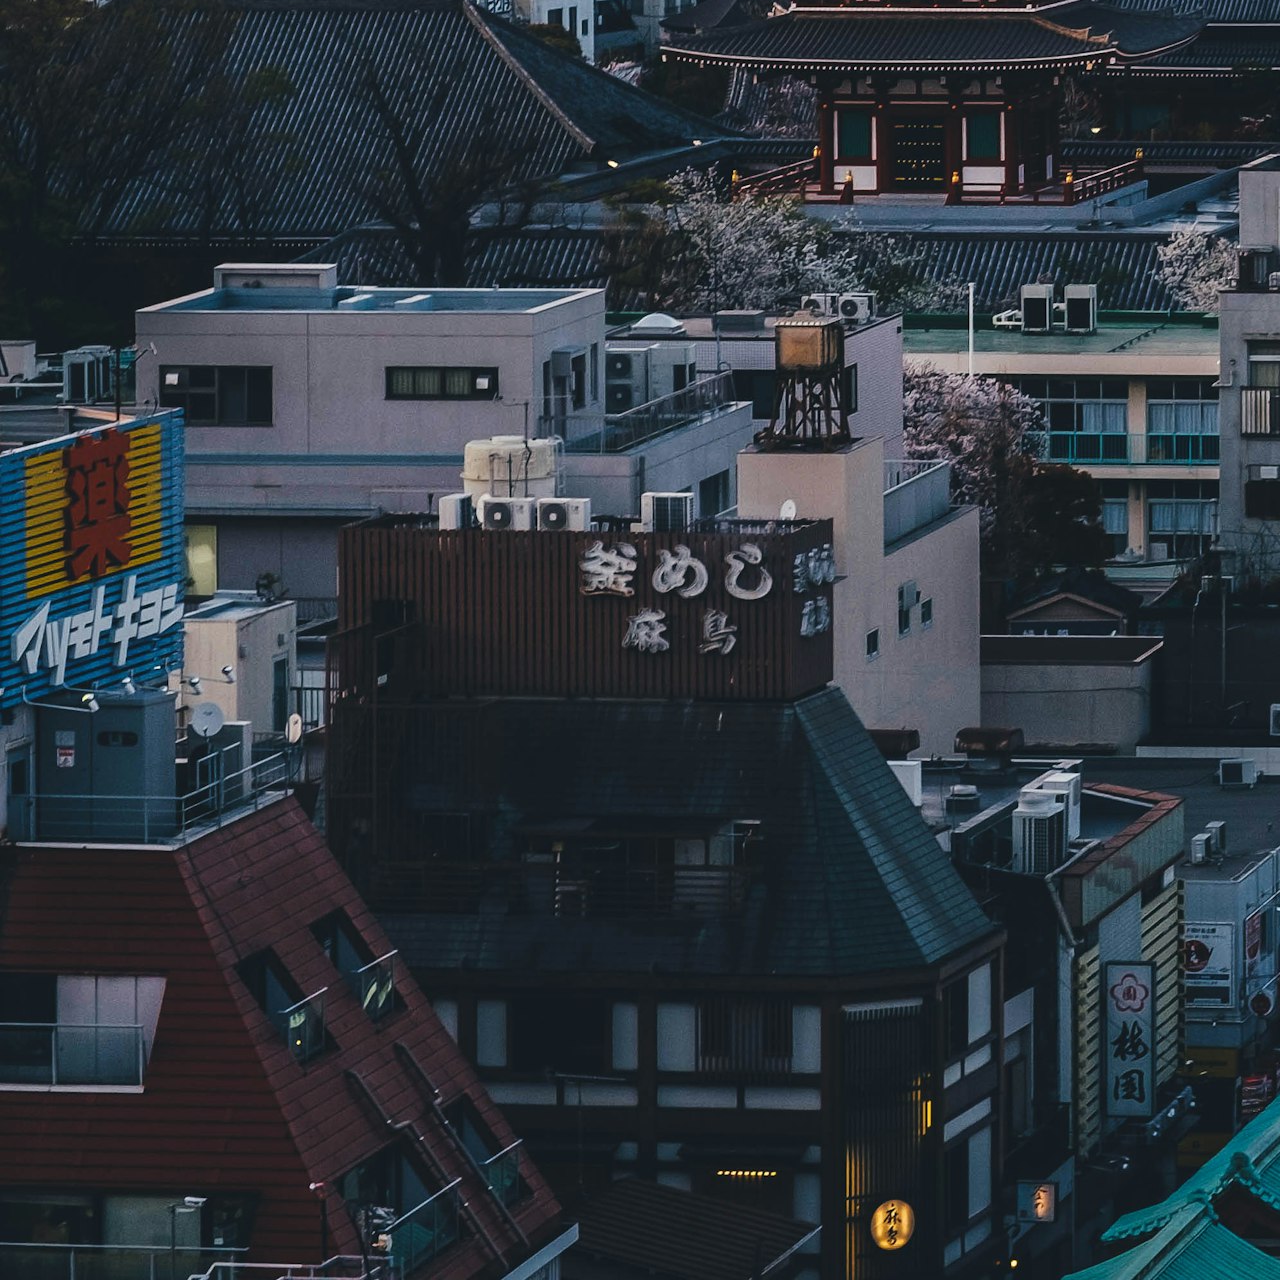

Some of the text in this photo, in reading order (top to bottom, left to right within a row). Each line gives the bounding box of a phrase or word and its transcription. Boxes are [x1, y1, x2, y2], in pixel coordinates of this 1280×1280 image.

[63, 427, 132, 580] 薬
[578, 540, 774, 600] 釜めし
[12, 574, 185, 687] マツモトキヨシ
[622, 607, 738, 656] 麻鳥
